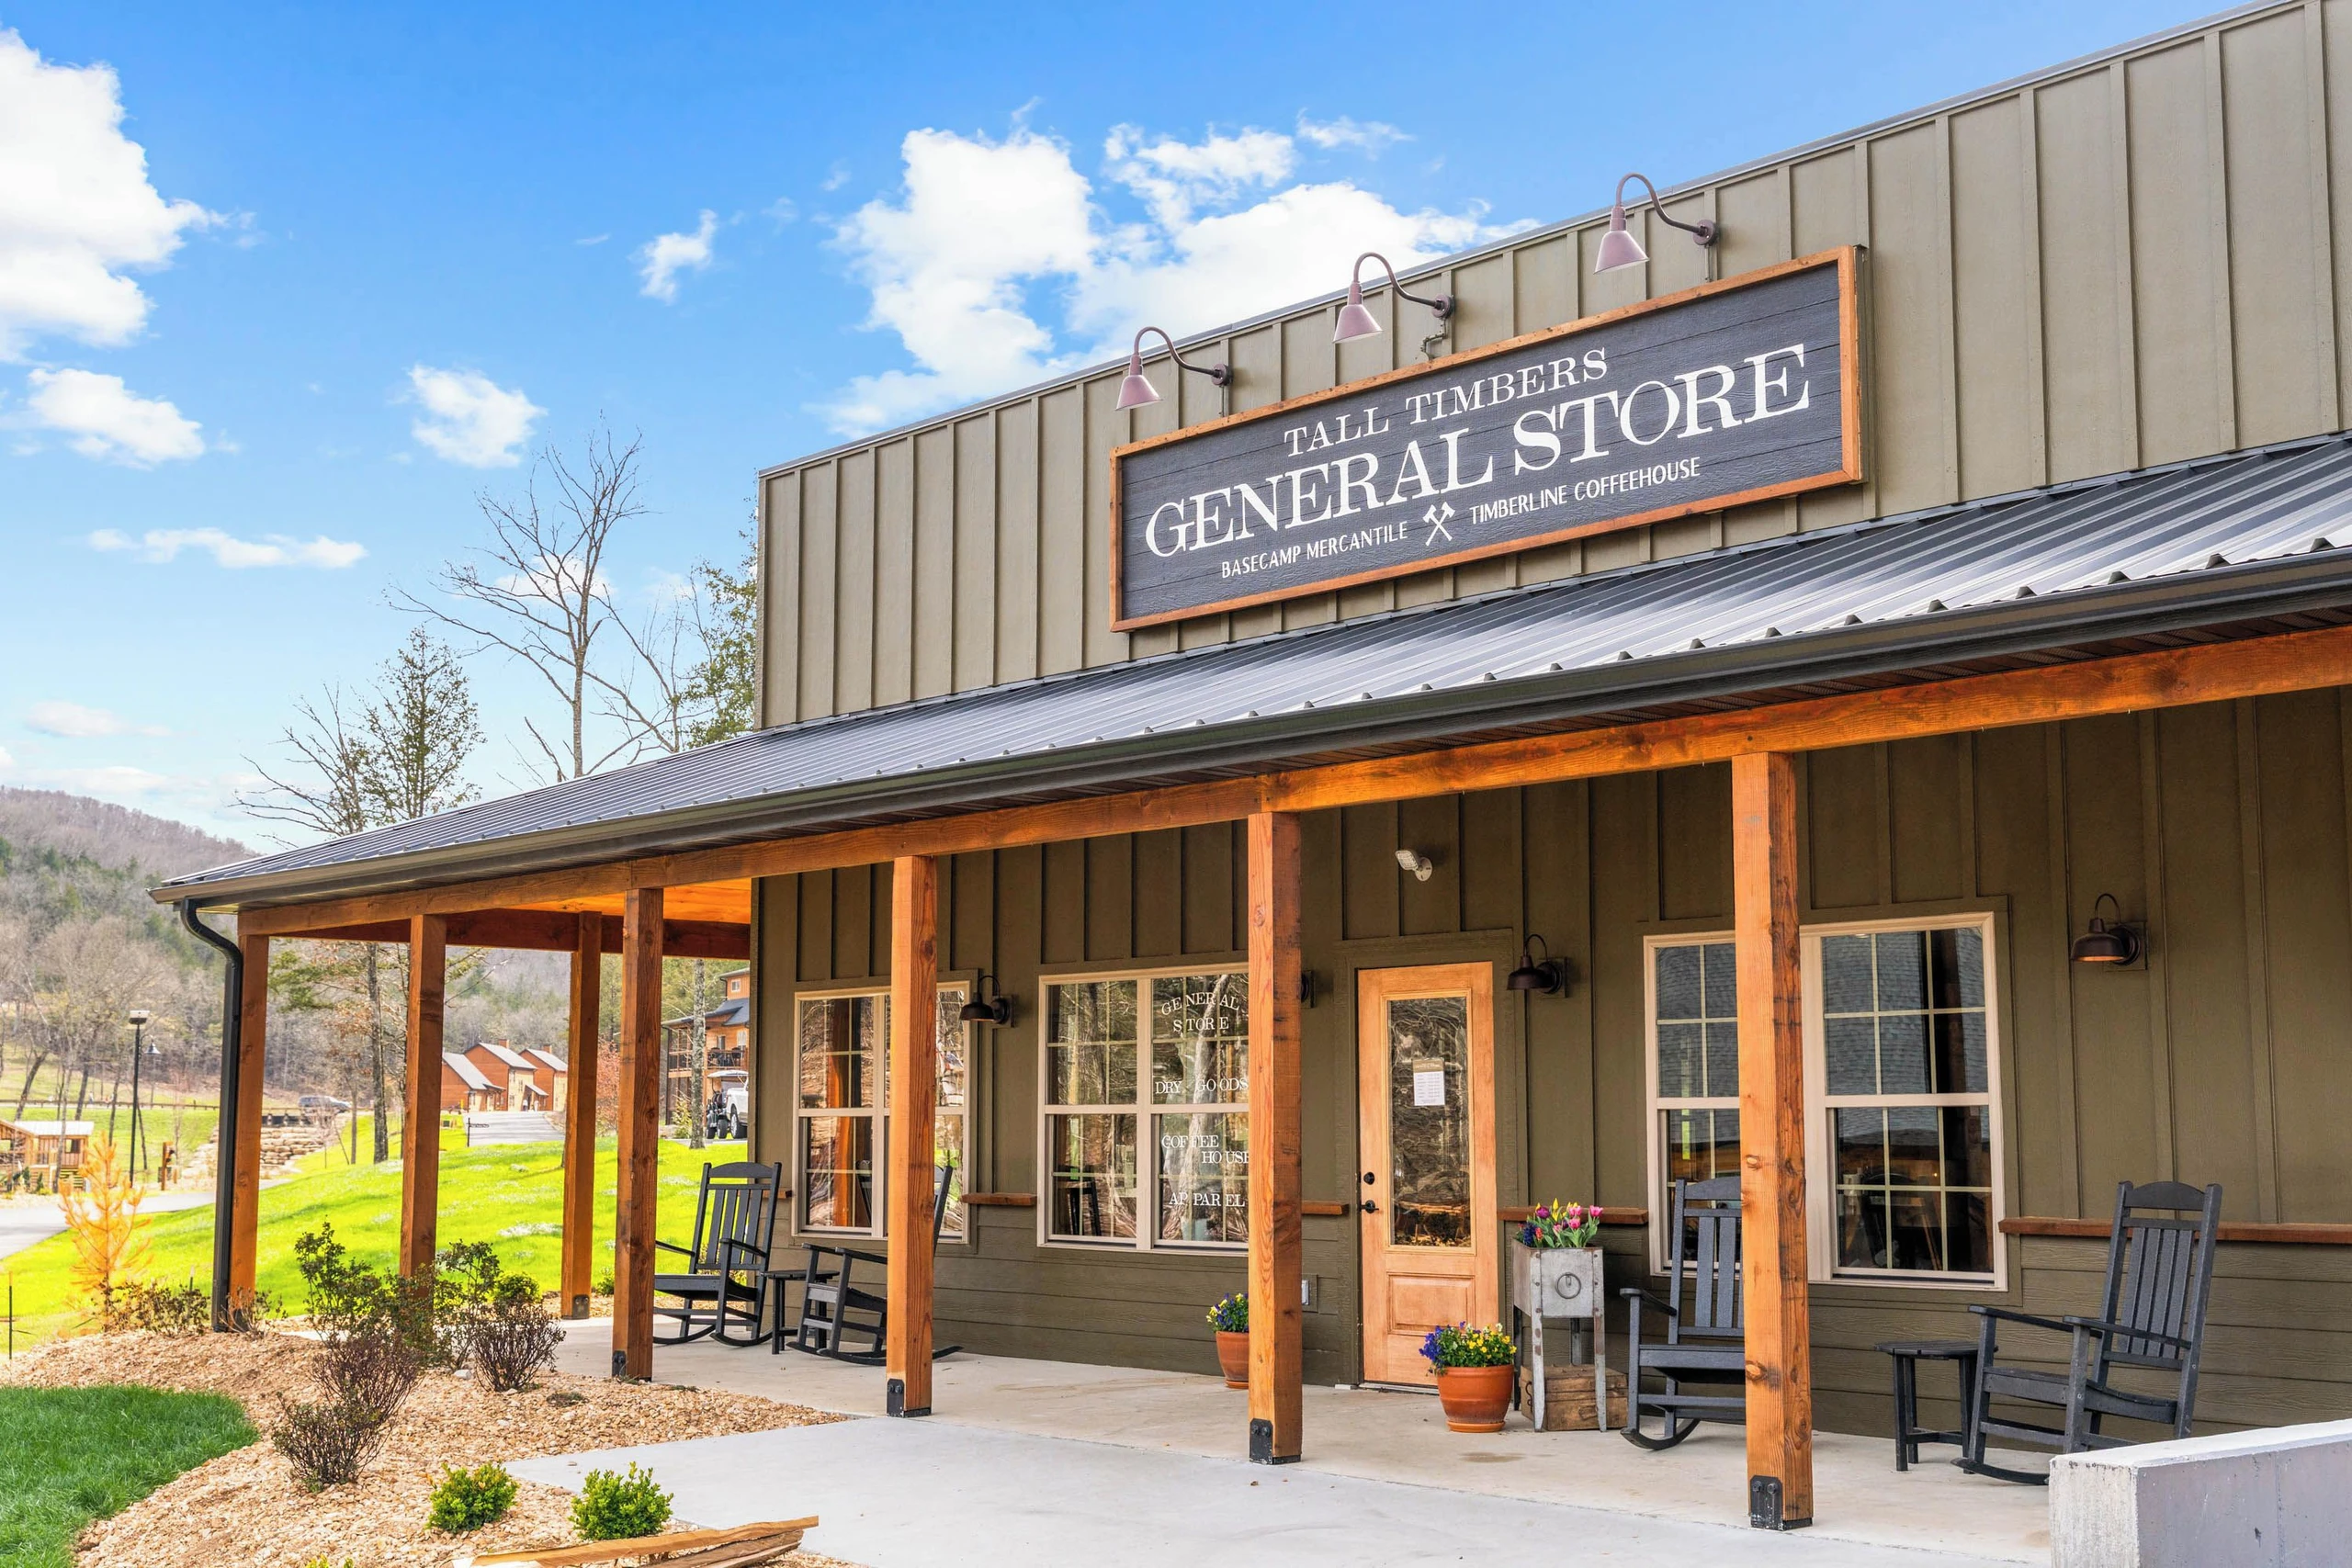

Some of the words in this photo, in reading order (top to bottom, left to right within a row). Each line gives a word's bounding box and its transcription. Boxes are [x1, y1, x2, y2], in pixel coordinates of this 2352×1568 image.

[1283, 407, 1389, 457] TALL
[1406, 347, 1609, 425] TIMBERS
[1145, 427, 1494, 558] GENERAL
[1512, 343, 1810, 476] STORE
[1221, 545, 1301, 579] BASECAMP
[1306, 521, 1408, 559] MERCANTILE
[1469, 484, 1568, 525] TIMBERLINE
[1574, 456, 1702, 502] COFFEEHOUSE
[1161, 992, 1239, 1015] GENERAL
[1173, 1016, 1229, 1032] STORE
[1155, 1080, 1182, 1094] DRY
[1195, 1077, 1249, 1092] GOODS
[1161, 1134, 1219, 1148] COFFEE
[1169, 1191, 1246, 1207] APPAREL
